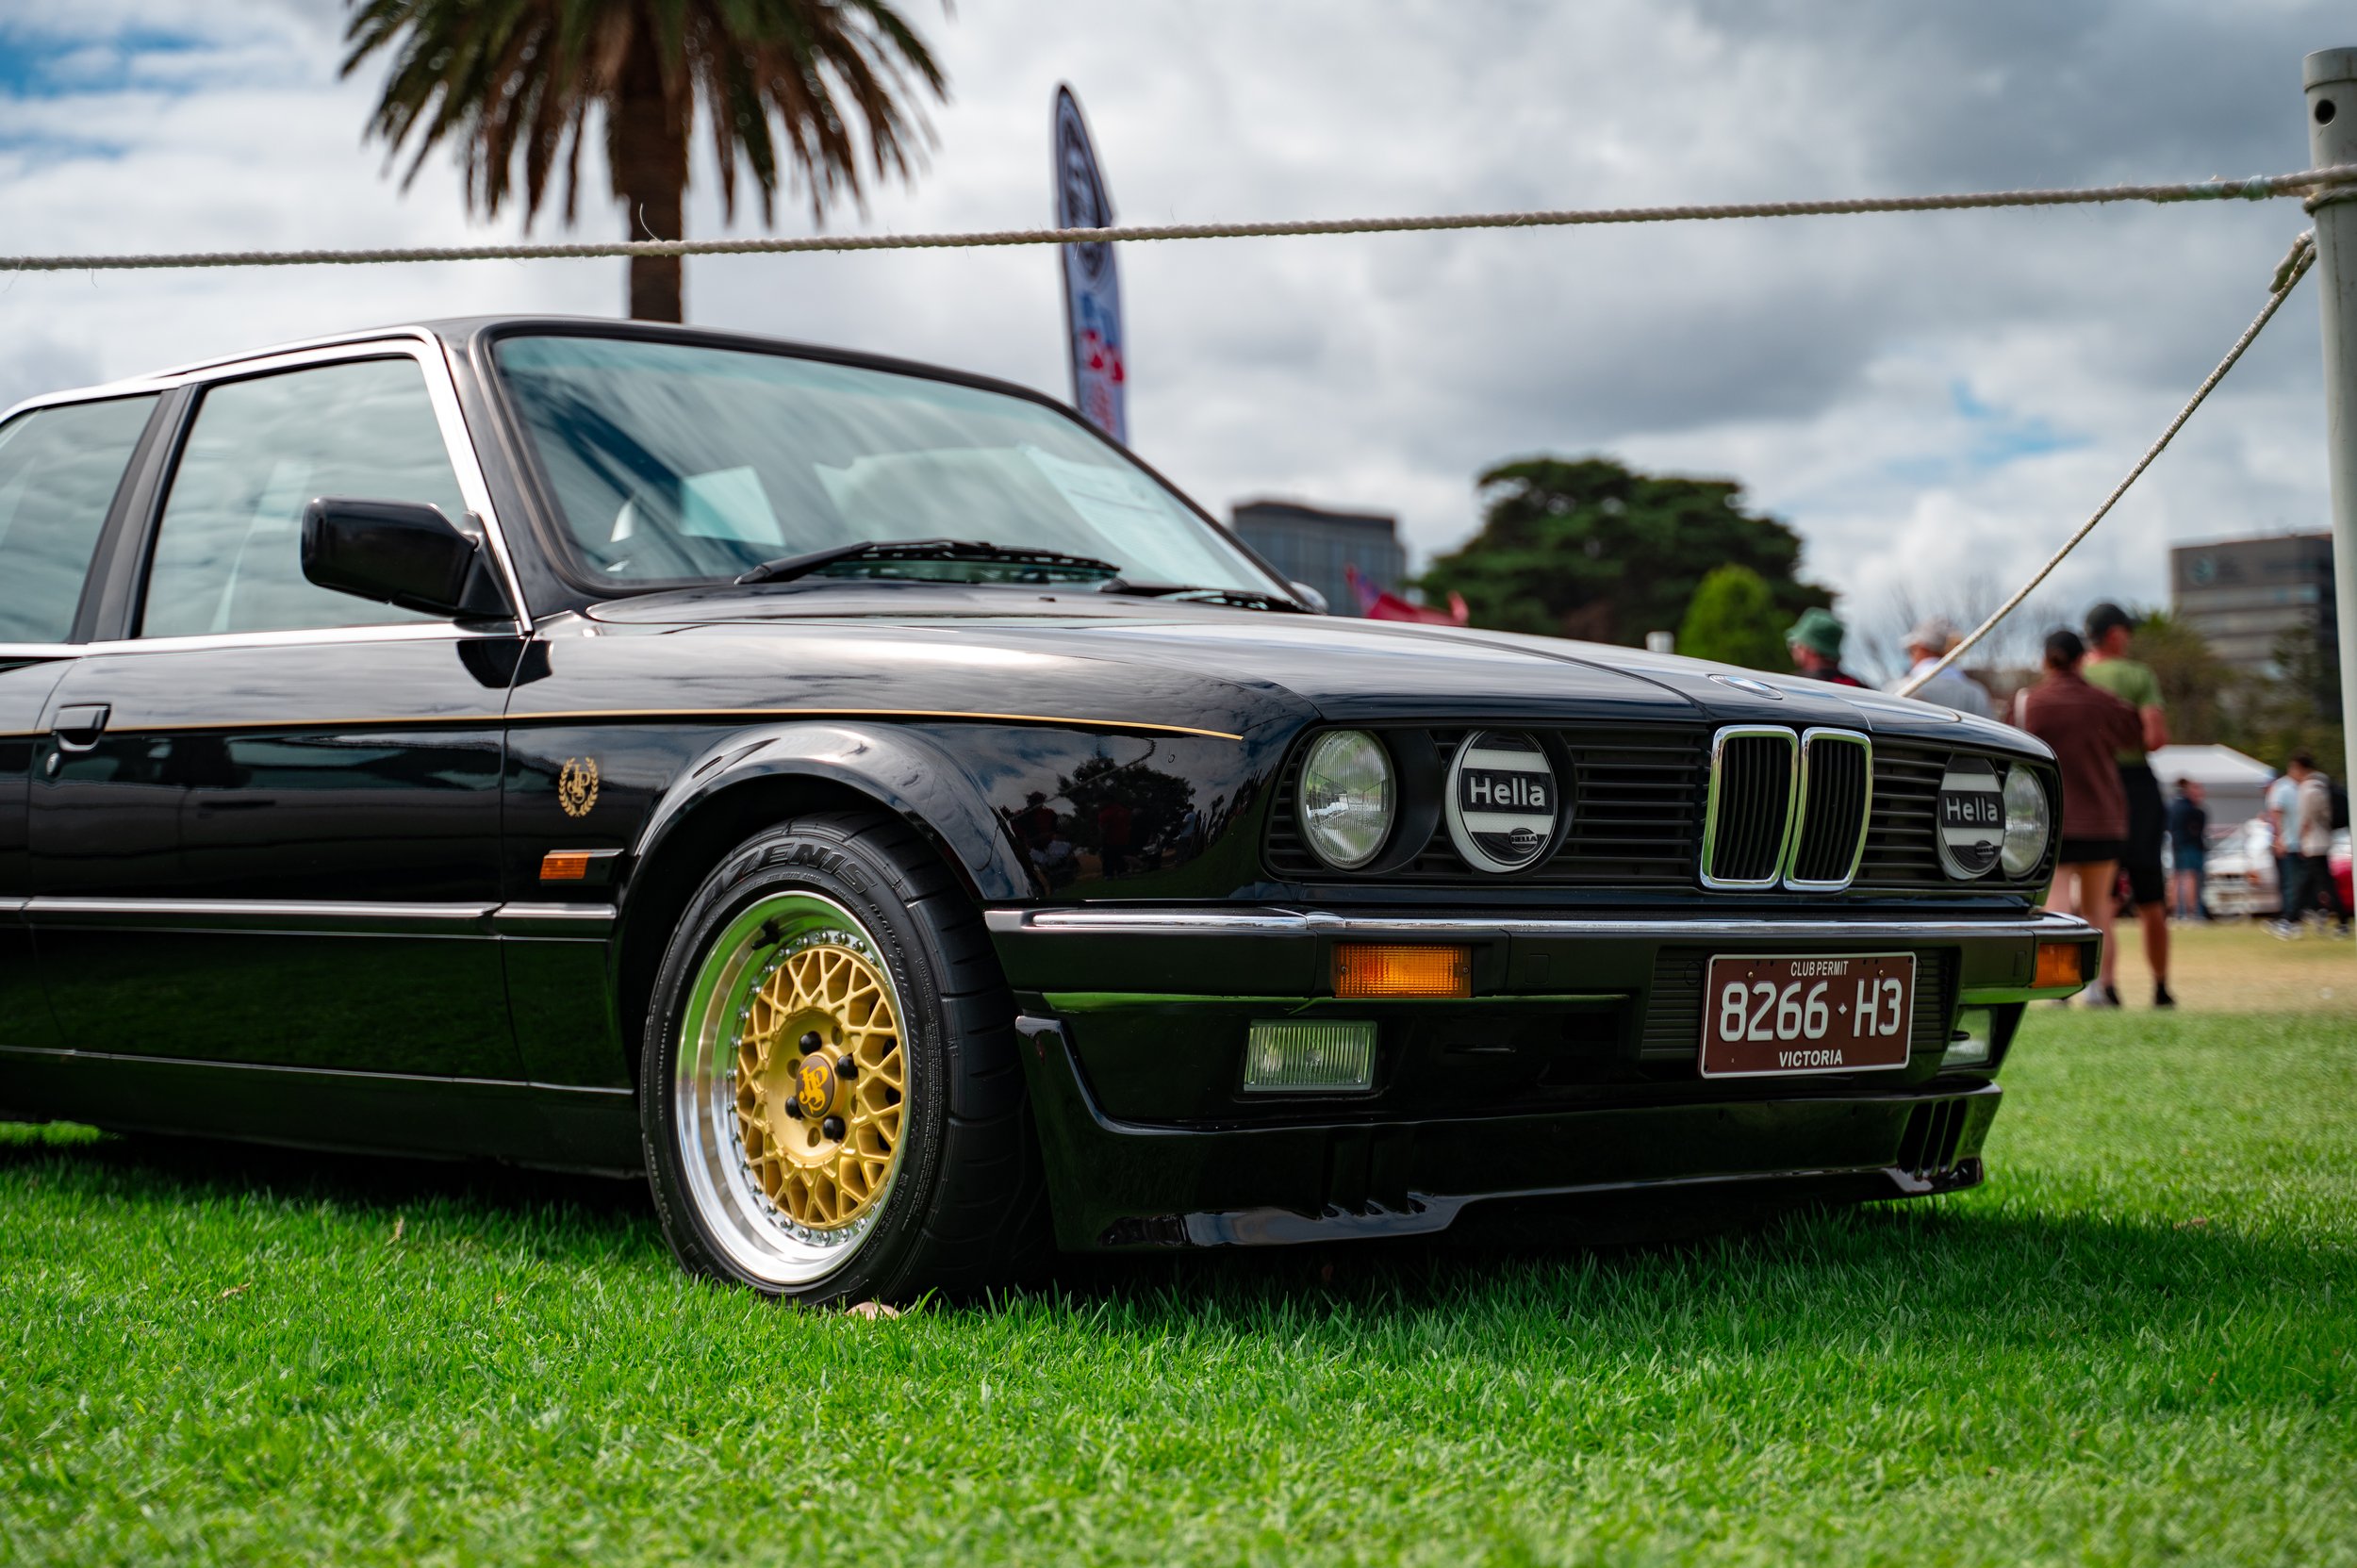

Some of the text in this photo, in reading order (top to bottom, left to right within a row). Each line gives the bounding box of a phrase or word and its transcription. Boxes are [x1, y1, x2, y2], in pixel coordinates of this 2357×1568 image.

[1470, 777, 1546, 807] Hella
[1946, 797, 1998, 822] Hella
[693, 843, 878, 934] AZENIS
[1790, 960, 1849, 977] CLUB PERMIT
[1779, 1049, 1843, 1067] VICTORIA
